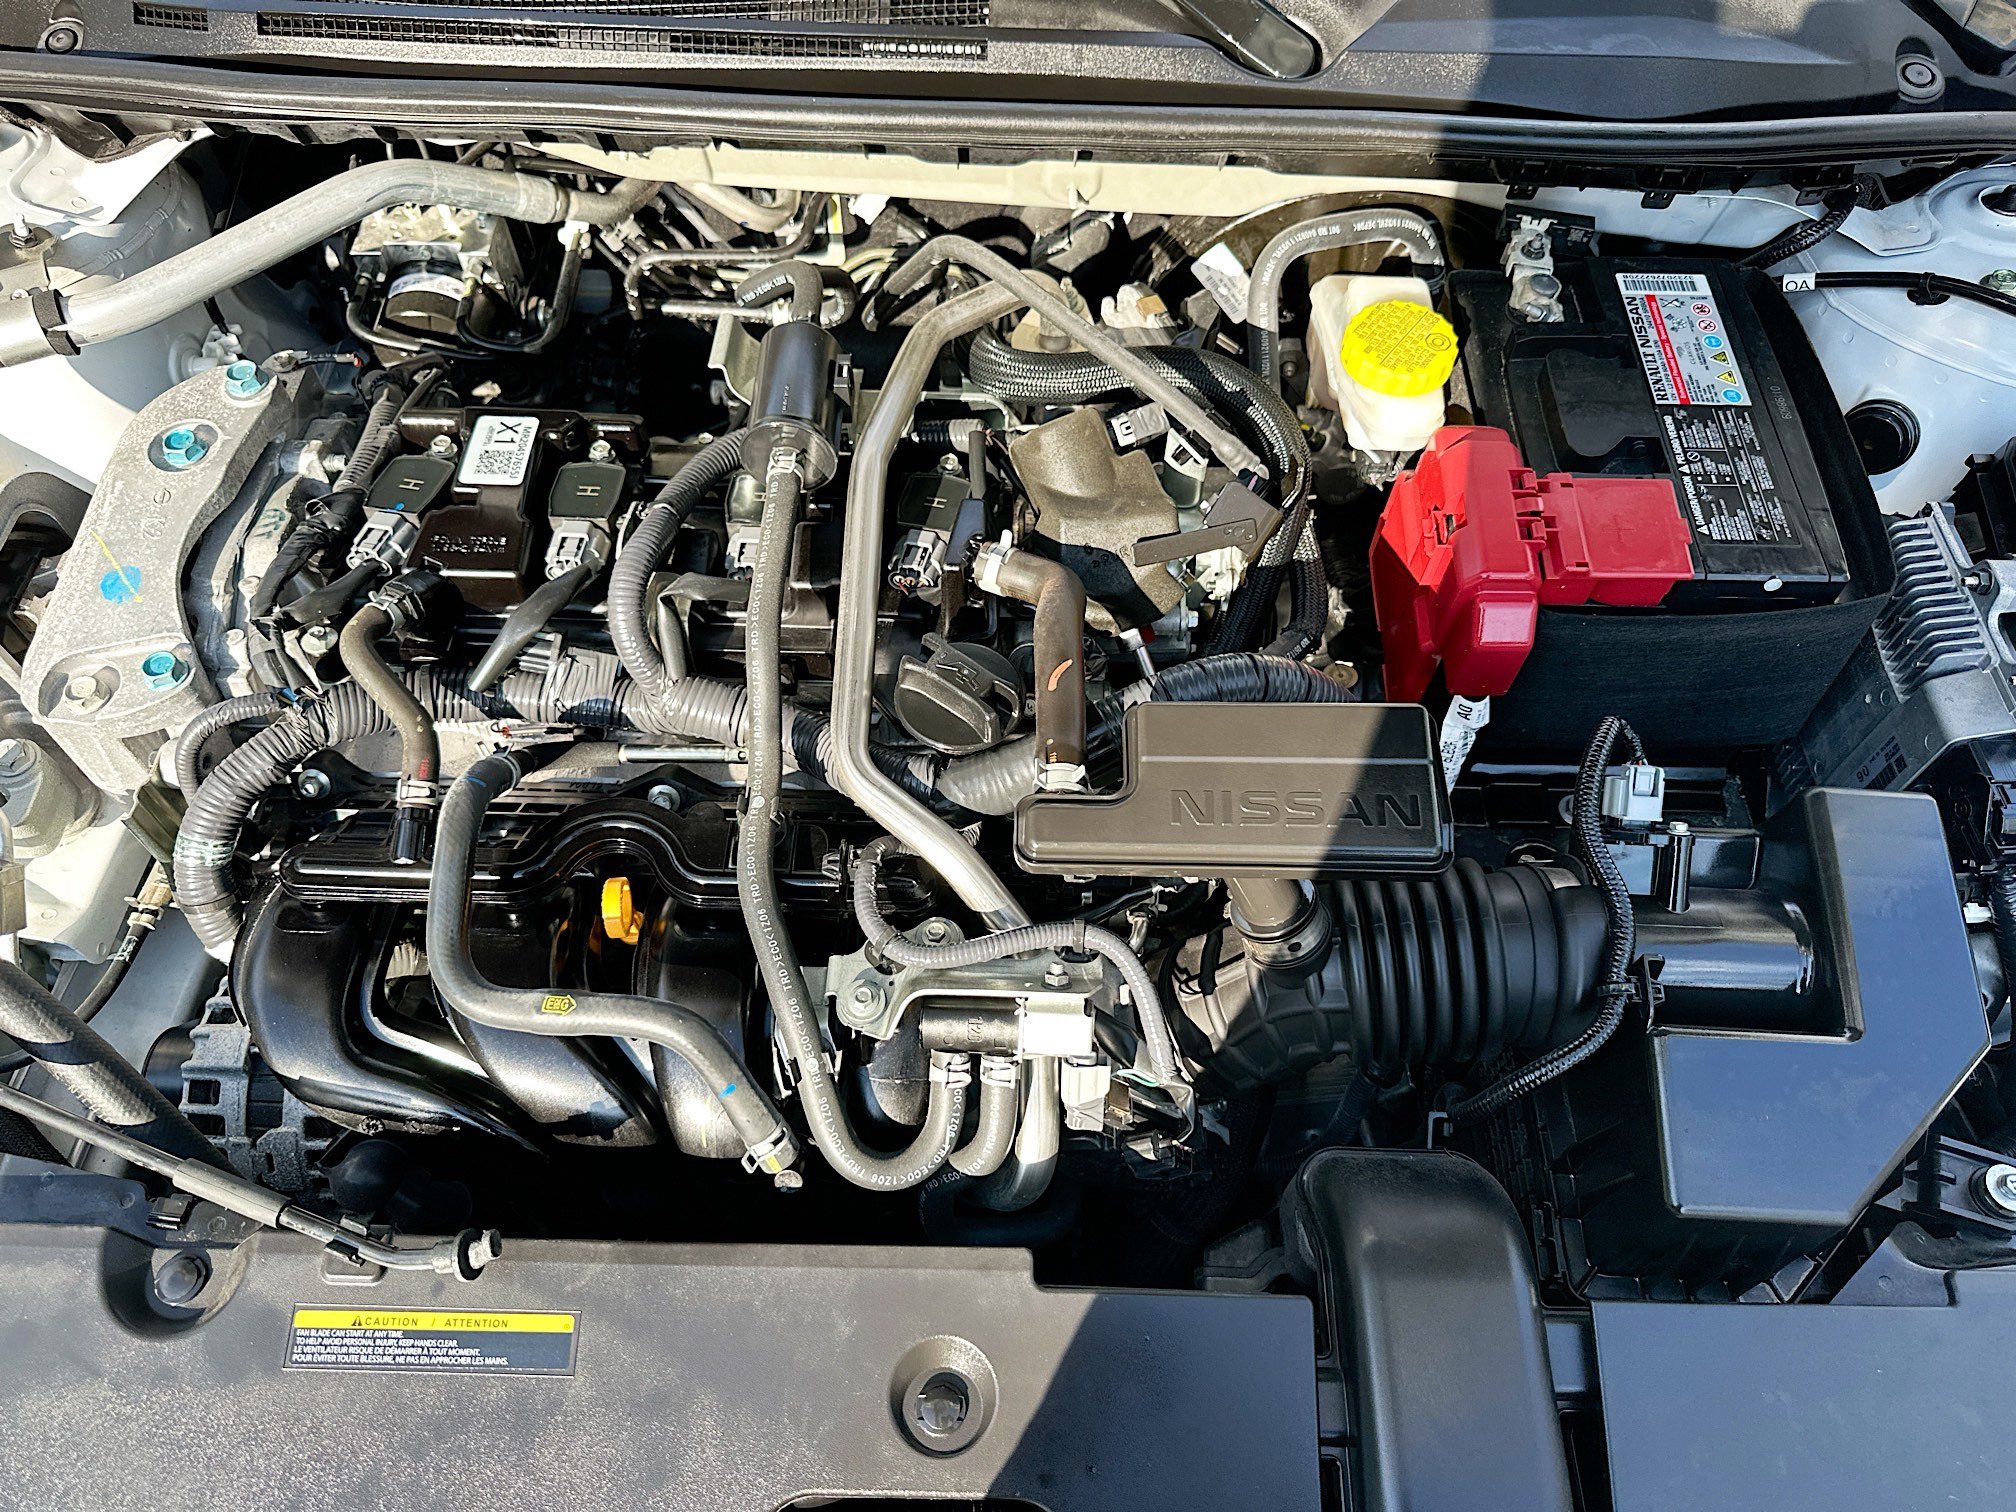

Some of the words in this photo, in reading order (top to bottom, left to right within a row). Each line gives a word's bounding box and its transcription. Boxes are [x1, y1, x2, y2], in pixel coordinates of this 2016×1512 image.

[1624, 296, 1652, 347] NISSAN
[1641, 351, 1669, 400] RENAULT
[494, 422, 522, 444] X1
[1662, 415, 1686, 464] PELIGRO/VENENO
[399, 478, 424, 490] H
[576, 485, 601, 496] H
[1681, 475, 1705, 524] DANGER/POISON
[752, 659, 763, 745] TRD>ECO<1Z06
[1170, 789, 1421, 828] NISSAN
[746, 826, 763, 904] TRD>ECO<1Z06
[757, 908, 792, 992] TRD>ECO<1Z06
[296, 1329, 310, 1337] FAN
[310, 1329, 331, 1337] BLADE
[346, 1330, 365, 1338] START
[374, 1330, 388, 1338] ANY
[365, 1317, 419, 1327] CAUTION
[444, 1318, 509, 1328] ATTENTION
[304, 1346, 348, 1354] VENTILATEUR
[349, 1347, 373, 1355] RISQUE
[322, 1338, 342, 1346] AVOID
[343, 1338, 375, 1346] PERSONAL
[398, 1339, 414, 1347] KEEP
[415, 1339, 437, 1347] HANDS
[292, 1354, 312, 1362] POUR
[406, 1355, 419, 1363] PAS
[430, 1356, 472, 1364] APPROCHER
